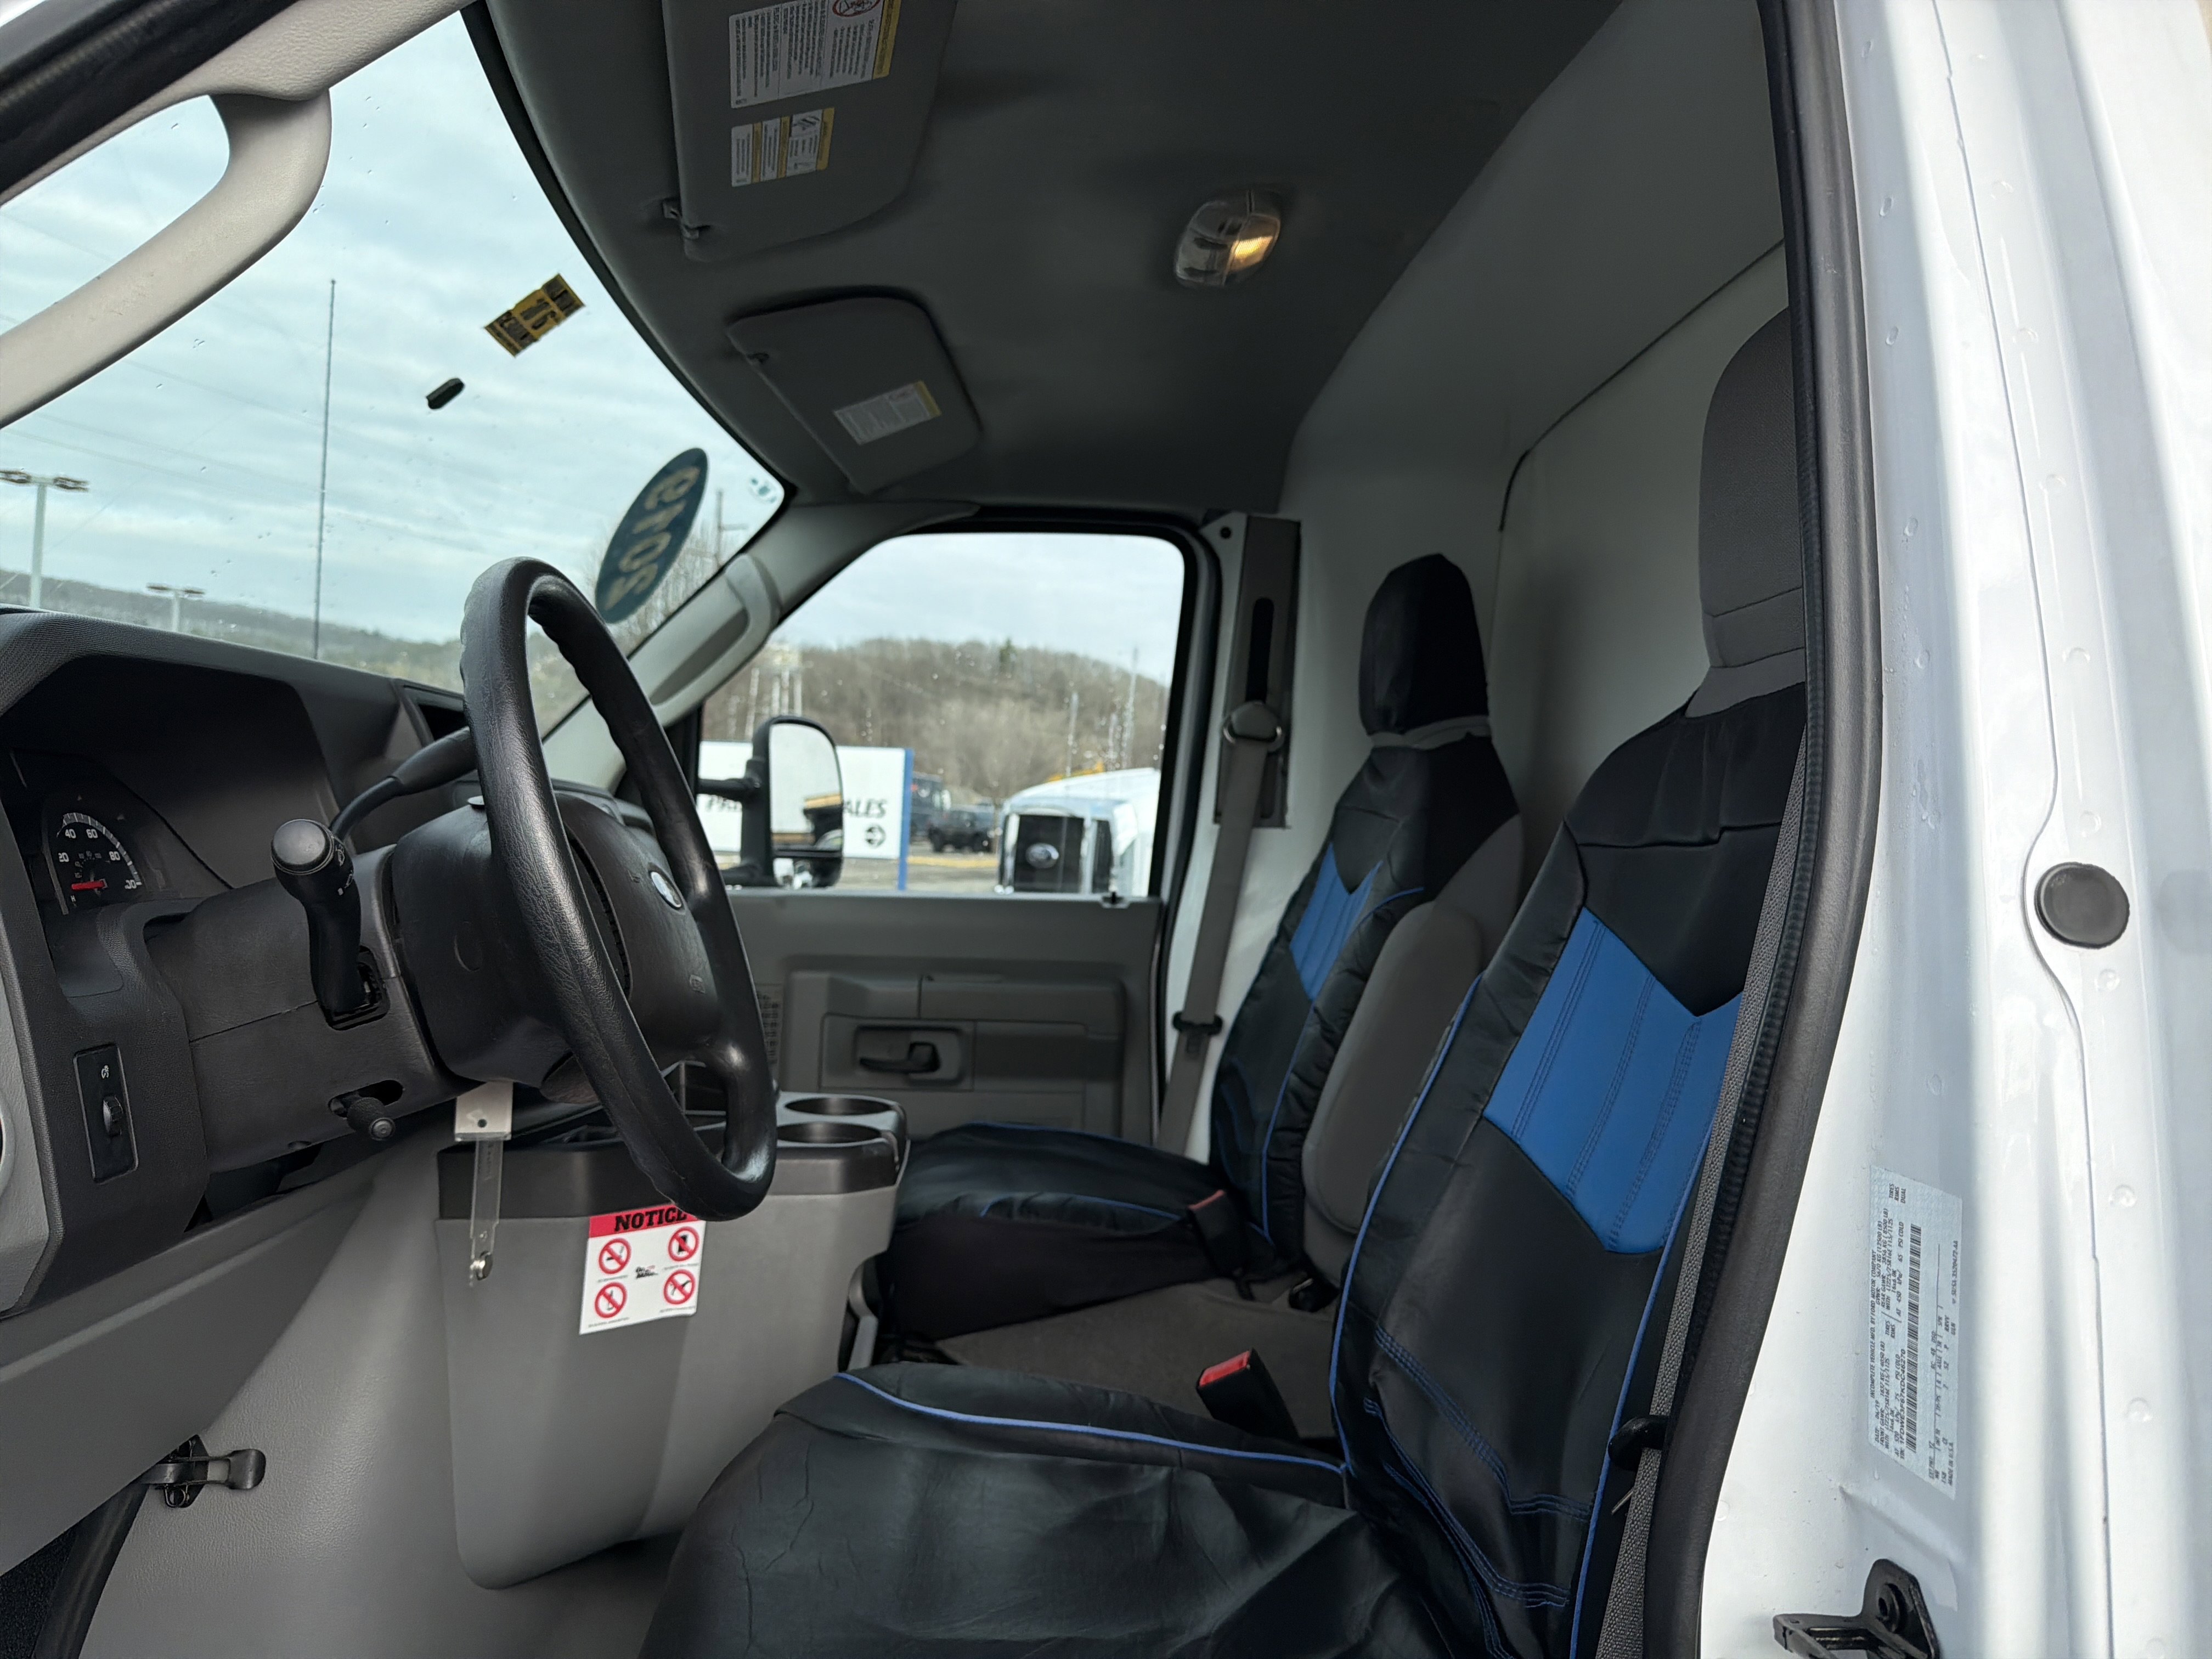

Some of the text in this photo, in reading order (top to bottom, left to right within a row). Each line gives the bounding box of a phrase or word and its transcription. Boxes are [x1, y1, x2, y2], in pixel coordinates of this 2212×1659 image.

[843, 798, 888, 818] ALES
[65, 829, 98, 839] 40 60
[109, 851, 121, 861] 80
[1880, 1373, 1884, 1381] KG
